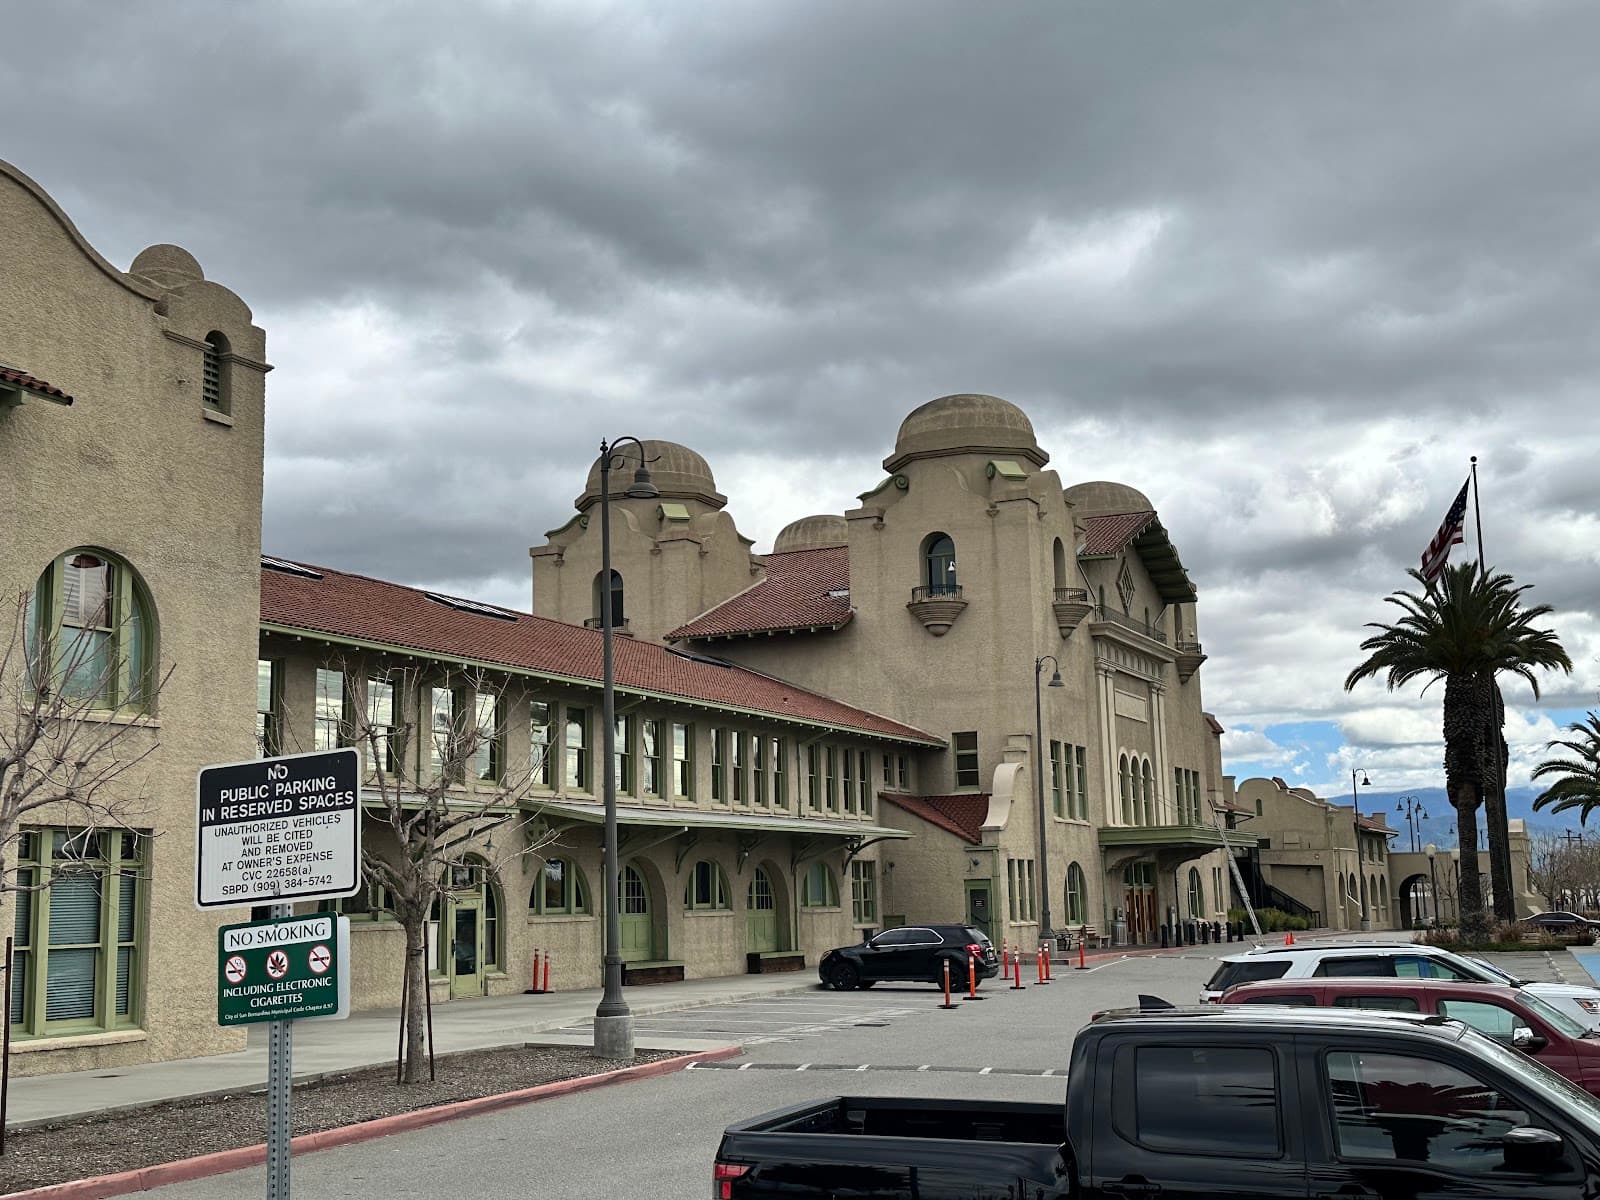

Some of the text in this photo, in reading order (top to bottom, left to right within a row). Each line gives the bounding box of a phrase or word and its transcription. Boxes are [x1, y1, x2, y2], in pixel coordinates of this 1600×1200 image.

[267, 766, 288, 781] NO
[220, 776, 336, 803] PUBLIC PARKING
[202, 791, 354, 822] IN RESERVED SPACES
[214, 814, 341, 837] UNAUTHORIZED VEHICLES
[241, 829, 313, 846] WILL BE CITED
[241, 841, 313, 858] AND REMOVED
[221, 850, 333, 872] AT OWNER'S EXPENSE
[241, 865, 312, 881] CVC 22658(a)
[222, 875, 332, 895] SBPD (909) 384-5742
[230, 922, 325, 947] NO SMOKING
[223, 976, 332, 997] INCLUDING ELECTRONIC
[250, 993, 303, 1008] CIGARETTES
